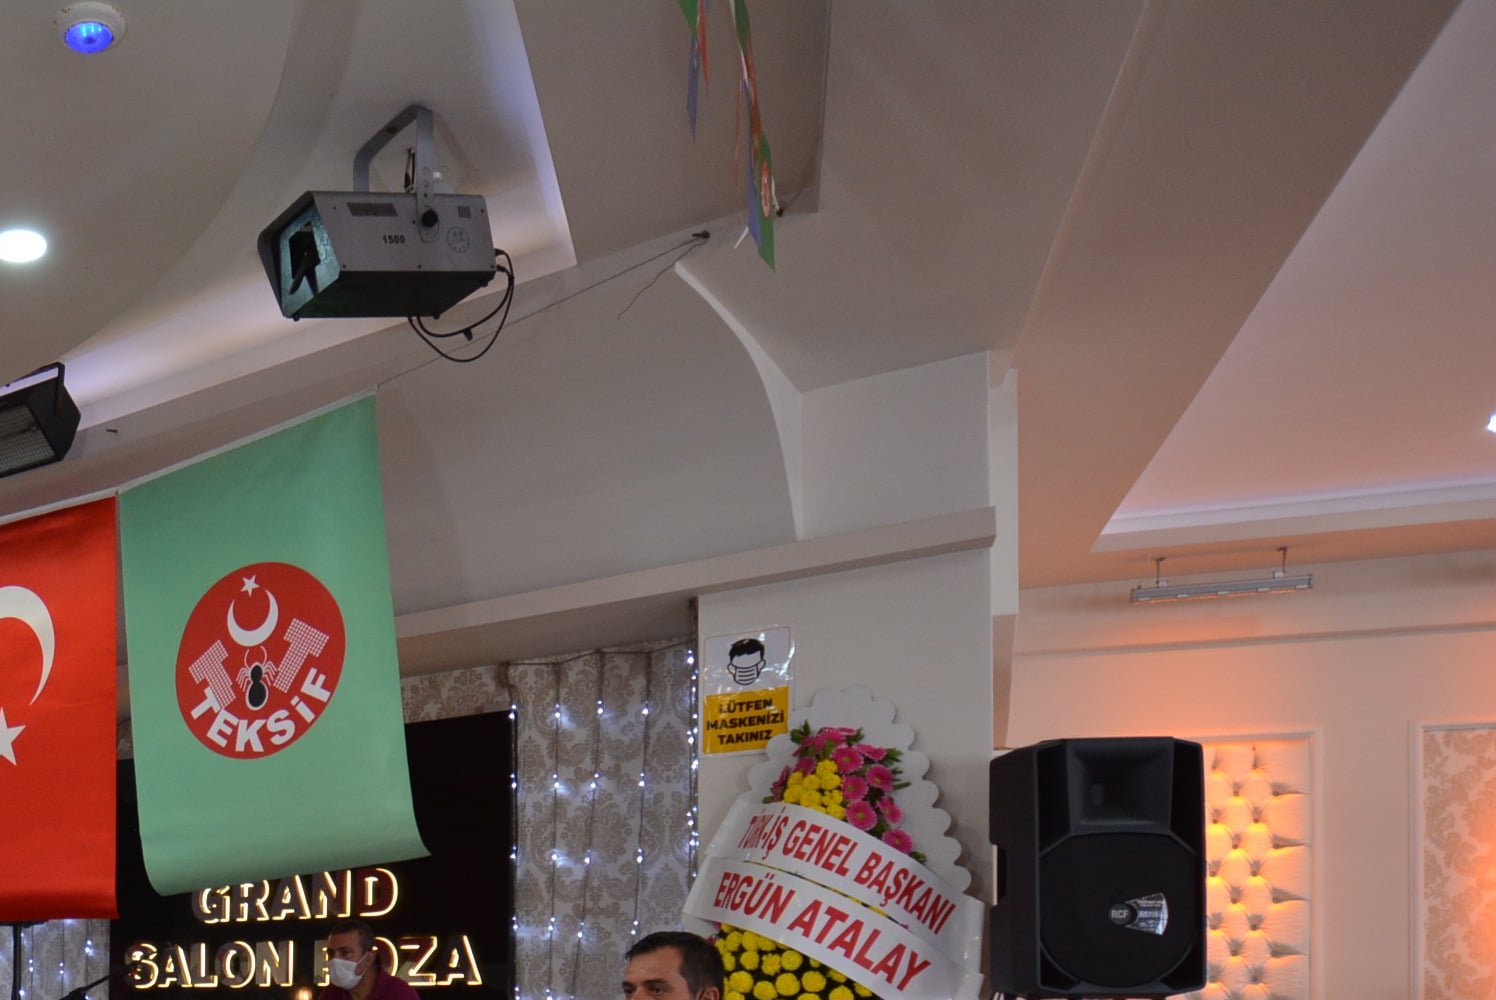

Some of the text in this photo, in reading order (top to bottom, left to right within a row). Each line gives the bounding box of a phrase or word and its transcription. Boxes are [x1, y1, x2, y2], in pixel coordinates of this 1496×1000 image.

[382, 234, 406, 245] 1500
[719, 698, 773, 714] LÜTFEN
[706, 709, 784, 731] MASKENİZİ
[718, 729, 773, 745] TAKINIZ
[782, 819, 858, 877] GENEL
[854, 851, 956, 935] BAŞKANI
[192, 868, 399, 924] GRAND
[1111, 909, 1129, 919] RCF
[713, 871, 931, 992] ERGÜN ATALAY
[125, 939, 294, 989] SALON
